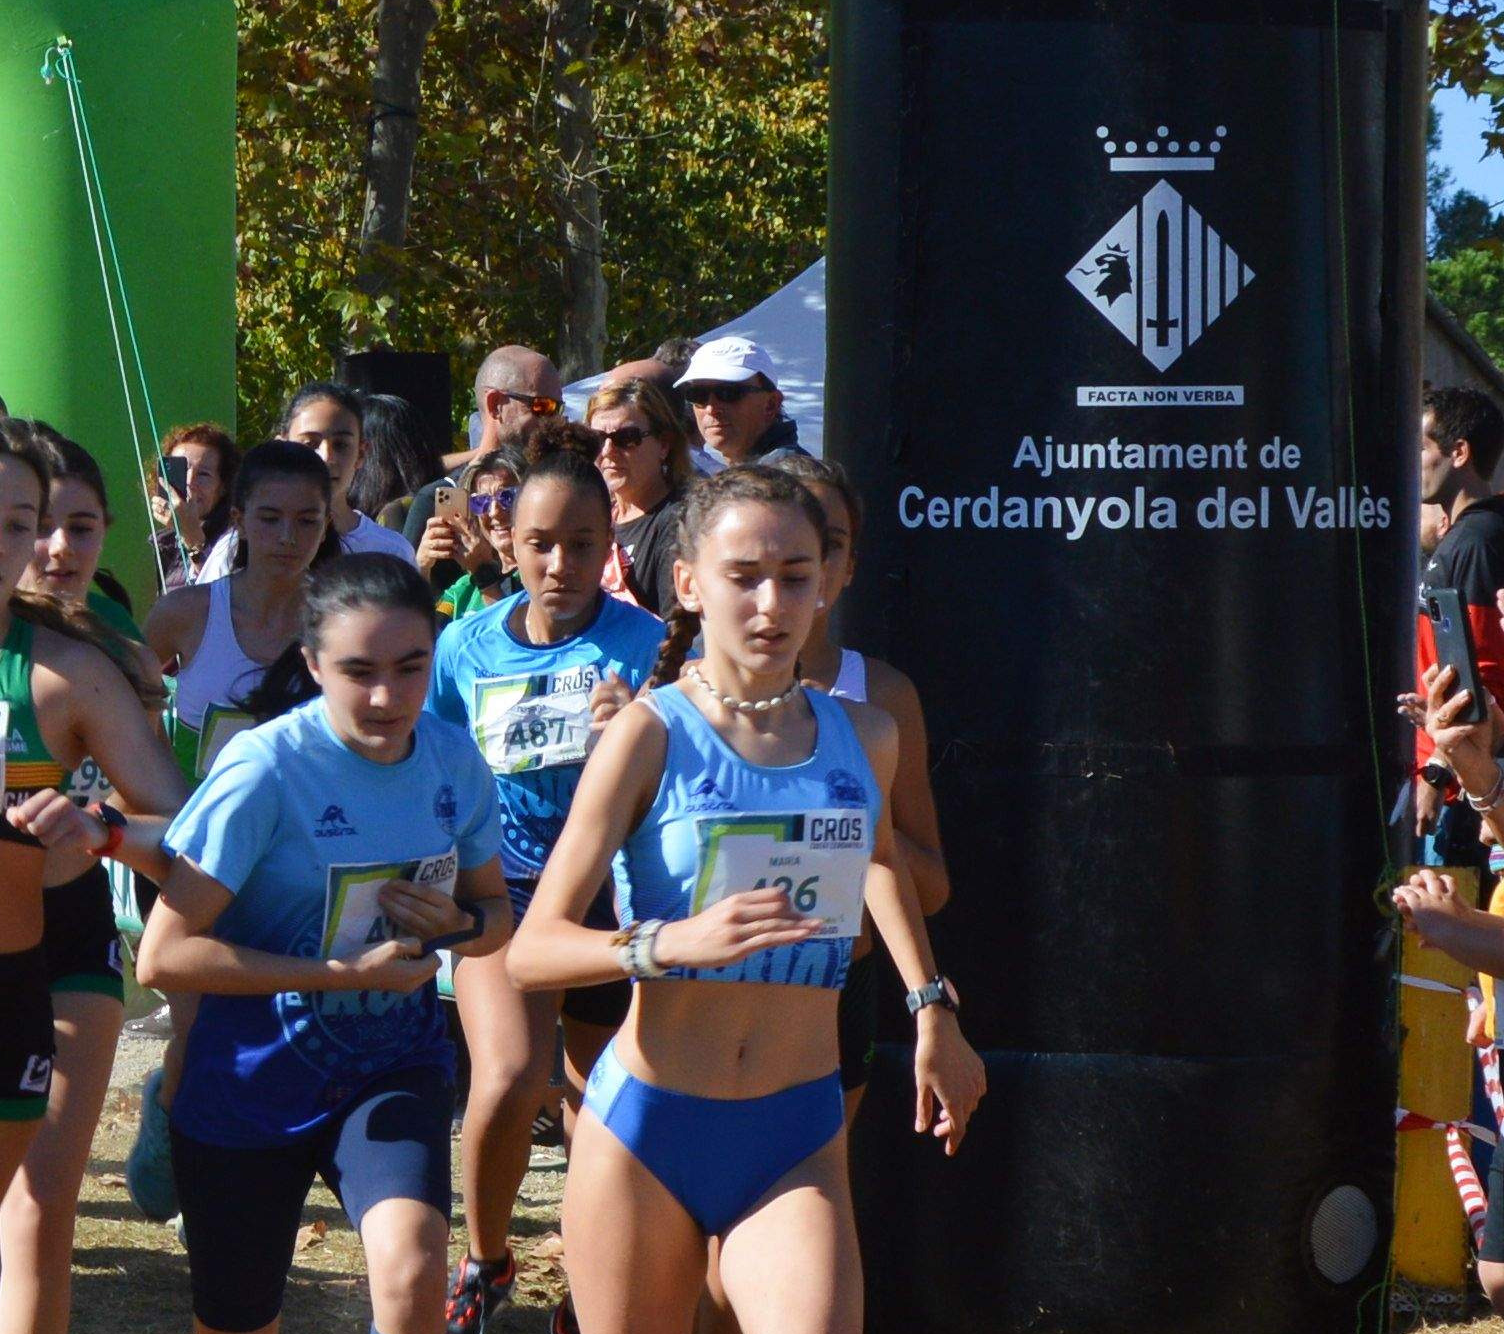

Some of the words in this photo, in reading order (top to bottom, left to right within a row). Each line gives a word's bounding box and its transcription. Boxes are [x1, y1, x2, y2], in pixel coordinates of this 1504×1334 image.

[1088, 390, 1138, 402] FACTA
[1144, 390, 1178, 402] NON
[1183, 390, 1235, 402] VERBA
[1013, 435, 1247, 477] Ajuntament
[1259, 436, 1301, 469] de
[898, 486, 1178, 540] Cerdanyola
[1197, 486, 1269, 529] del
[1286, 486, 1391, 529] Vallès
[552, 670, 594, 694] CROS
[509, 716, 566, 750] 487
[809, 817, 863, 842] CROS
[769, 855, 800, 867] MARIA
